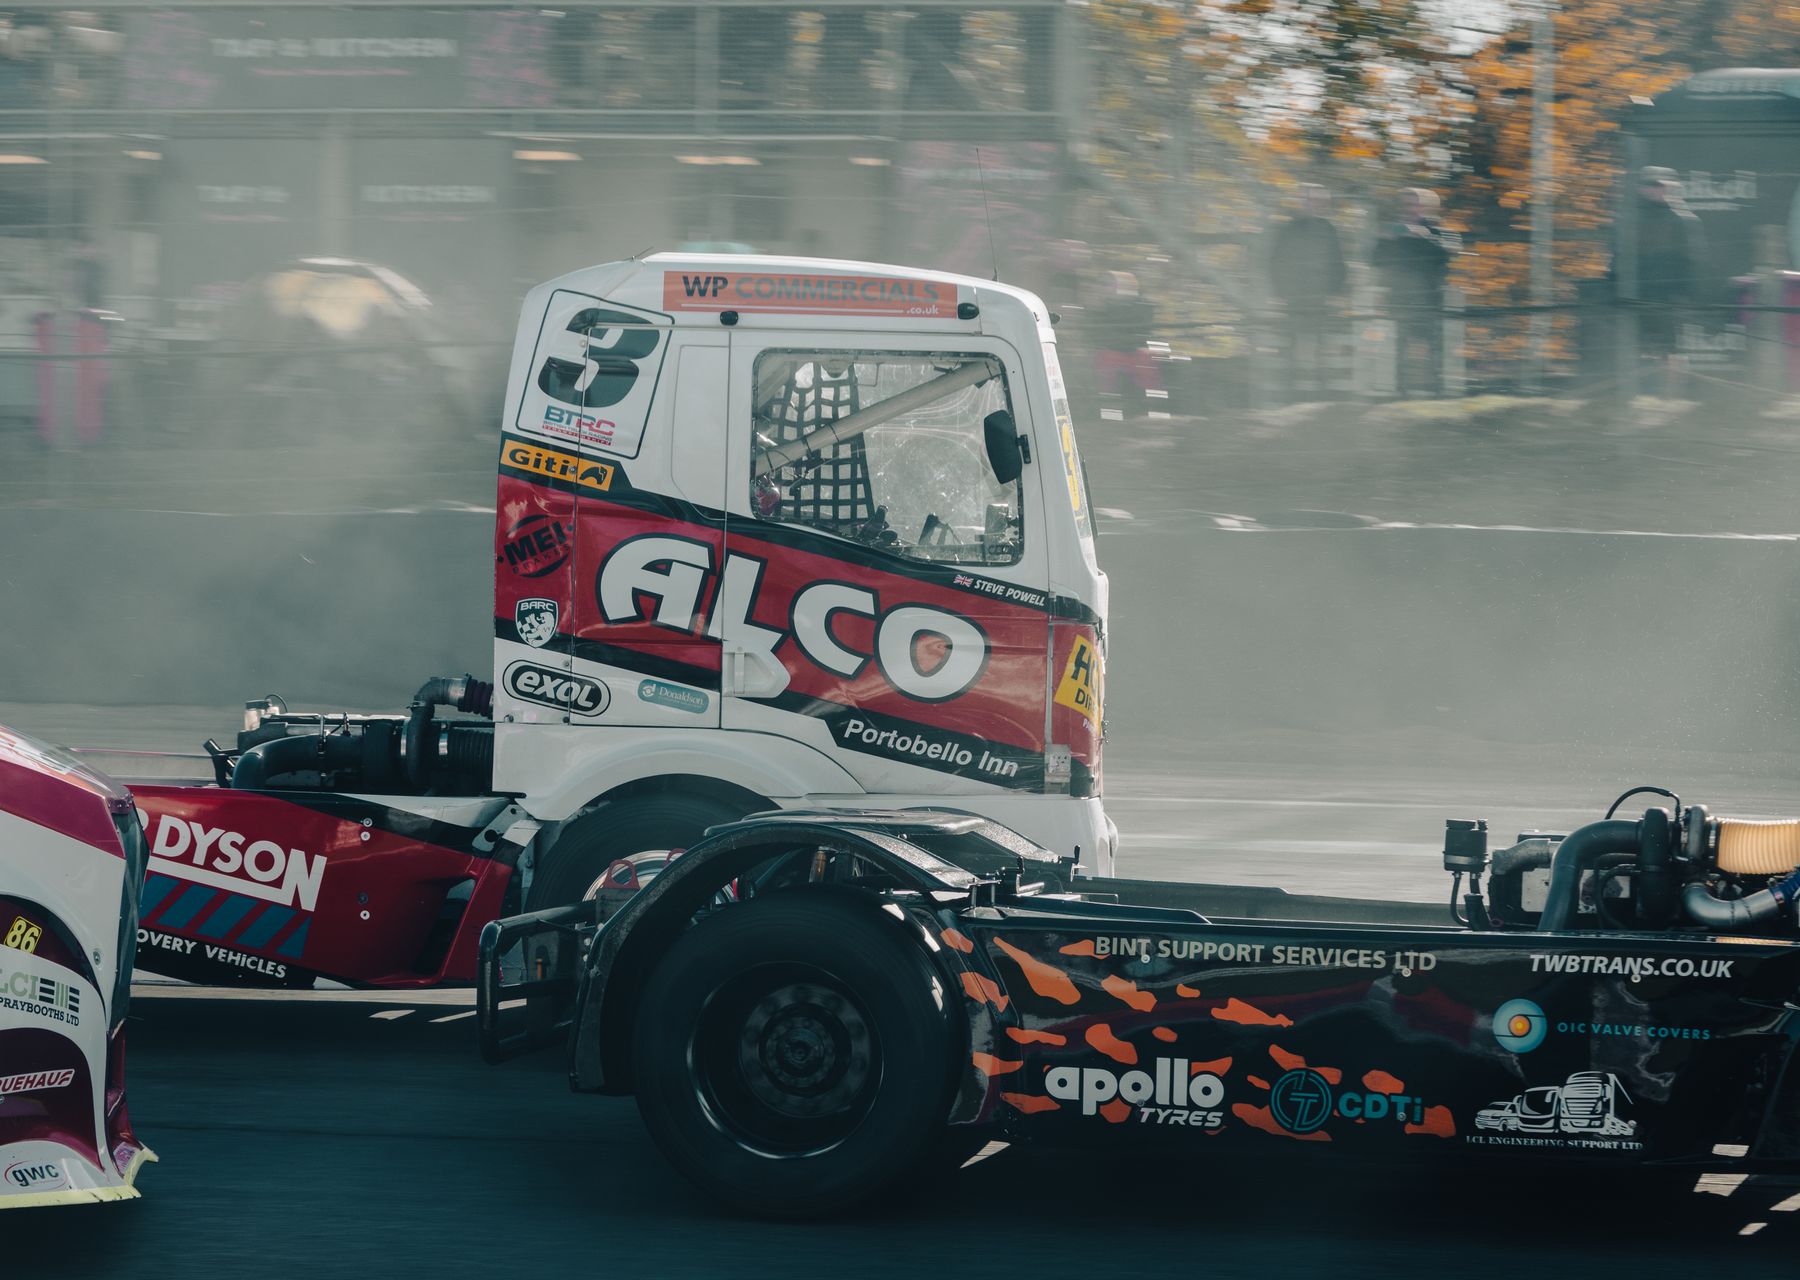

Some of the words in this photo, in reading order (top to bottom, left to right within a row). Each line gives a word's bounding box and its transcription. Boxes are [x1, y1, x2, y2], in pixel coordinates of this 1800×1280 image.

[682, 275, 728, 298] WP
[734, 277, 938, 303] COMMERCIALS
[906, 305, 939, 315] .co.uk
[538, 307, 660, 409] 3
[544, 405, 616, 436] BTRC
[509, 448, 571, 476] Giti
[503, 521, 566, 566] MEI
[520, 601, 554, 612] BARC
[974, 579, 1006, 595] STEVE
[1005, 588, 1045, 607] POWELL
[598, 535, 988, 701] ALCO
[658, 686, 704, 705] Donaldson
[844, 719, 973, 766] Portobello
[978, 750, 1019, 778] Inn
[152, 814, 328, 912] DYSON
[6, 919, 39, 953] 86
[1095, 936, 1150, 957] BINT
[1157, 939, 1265, 963] SUPPORT
[1271, 945, 1387, 968] SERVICES
[1394, 950, 1437, 971] LTD
[1530, 953, 1735, 978] TWBTRANS.CO.UK
[66, 1013, 80, 1027] LTD
[1557, 1022, 1586, 1034] OIC
[1591, 1023, 1642, 1037] VALVE
[1647, 1026, 1711, 1040] COVERS
[0, 1070, 74, 1093] UEHAUF
[1044, 1056, 1225, 1116] apollo
[1138, 1106, 1224, 1127] TYRES
[1489, 1136, 1564, 1147] ENGINEERING
[1567, 1139, 1620, 1149] SUPPORT
[1622, 1141, 1643, 1150] LTD
[11, 1164, 60, 1187] gwc
